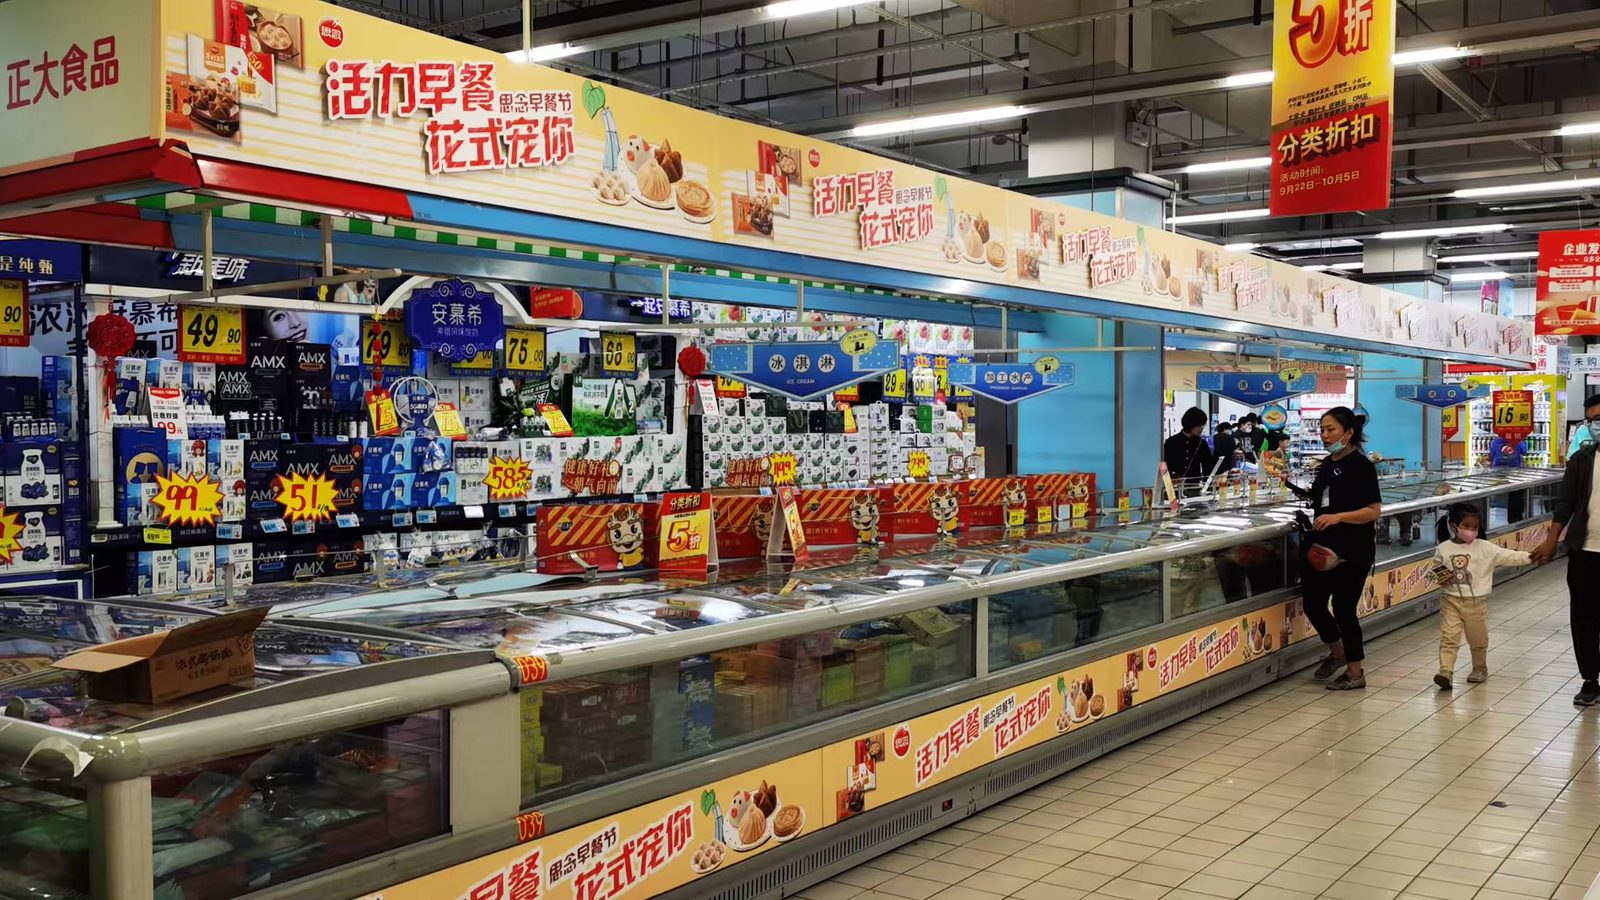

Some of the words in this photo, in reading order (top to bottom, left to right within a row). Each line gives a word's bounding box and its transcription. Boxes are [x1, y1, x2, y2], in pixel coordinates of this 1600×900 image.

[6, 35, 120, 110] 正大食品
[328, 61, 496, 117] 活力早餐
[500, 92, 573, 114] 思念早餐节
[426, 116, 576, 171] 花式宠你
[1278, 113, 1374, 164] 分类折扣
[813, 170, 895, 216] 活力早餐
[895, 185, 934, 201] 思念早餐节
[861, 204, 935, 248] 花式宠你
[1063, 226, 1111, 263] 活力早餐
[1091, 251, 1138, 287] 花式宠你
[4, 305, 21, 322] 90
[431, 302, 482, 326] 安慕希
[187, 313, 219, 347] 49
[227, 328, 241, 343] 90
[251, 355, 286, 369] AMX
[298, 351, 327, 364] AMX
[508, 337, 528, 365] 75
[605, 340, 623, 367] 68
[771, 355, 834, 371] 冰淇淋
[217, 370, 248, 383] AMX
[223, 383, 250, 395] AMX
[885, 374, 897, 393] 29
[985, 372, 1033, 383] 加工水产
[1497, 406, 1515, 424] 15
[249, 450, 279, 462] AMX
[285, 462, 320, 476] AMX
[565, 457, 611, 476] 健康好礼
[165, 484, 198, 511] 99
[291, 483, 318, 512] 51
[573, 476, 618, 494] 朝气向前
[670, 494, 701, 512] 分类折扣
[1160, 635, 1198, 690] 活力早餐
[1205, 624, 1239, 674] 花式宠你
[983, 695, 1015, 729] 思念早餐节
[994, 686, 1052, 755] 花式宠你
[916, 706, 981, 785] 活力早餐
[549, 826, 617, 882] 思念早餐节
[574, 804, 693, 900] 花式宠你
